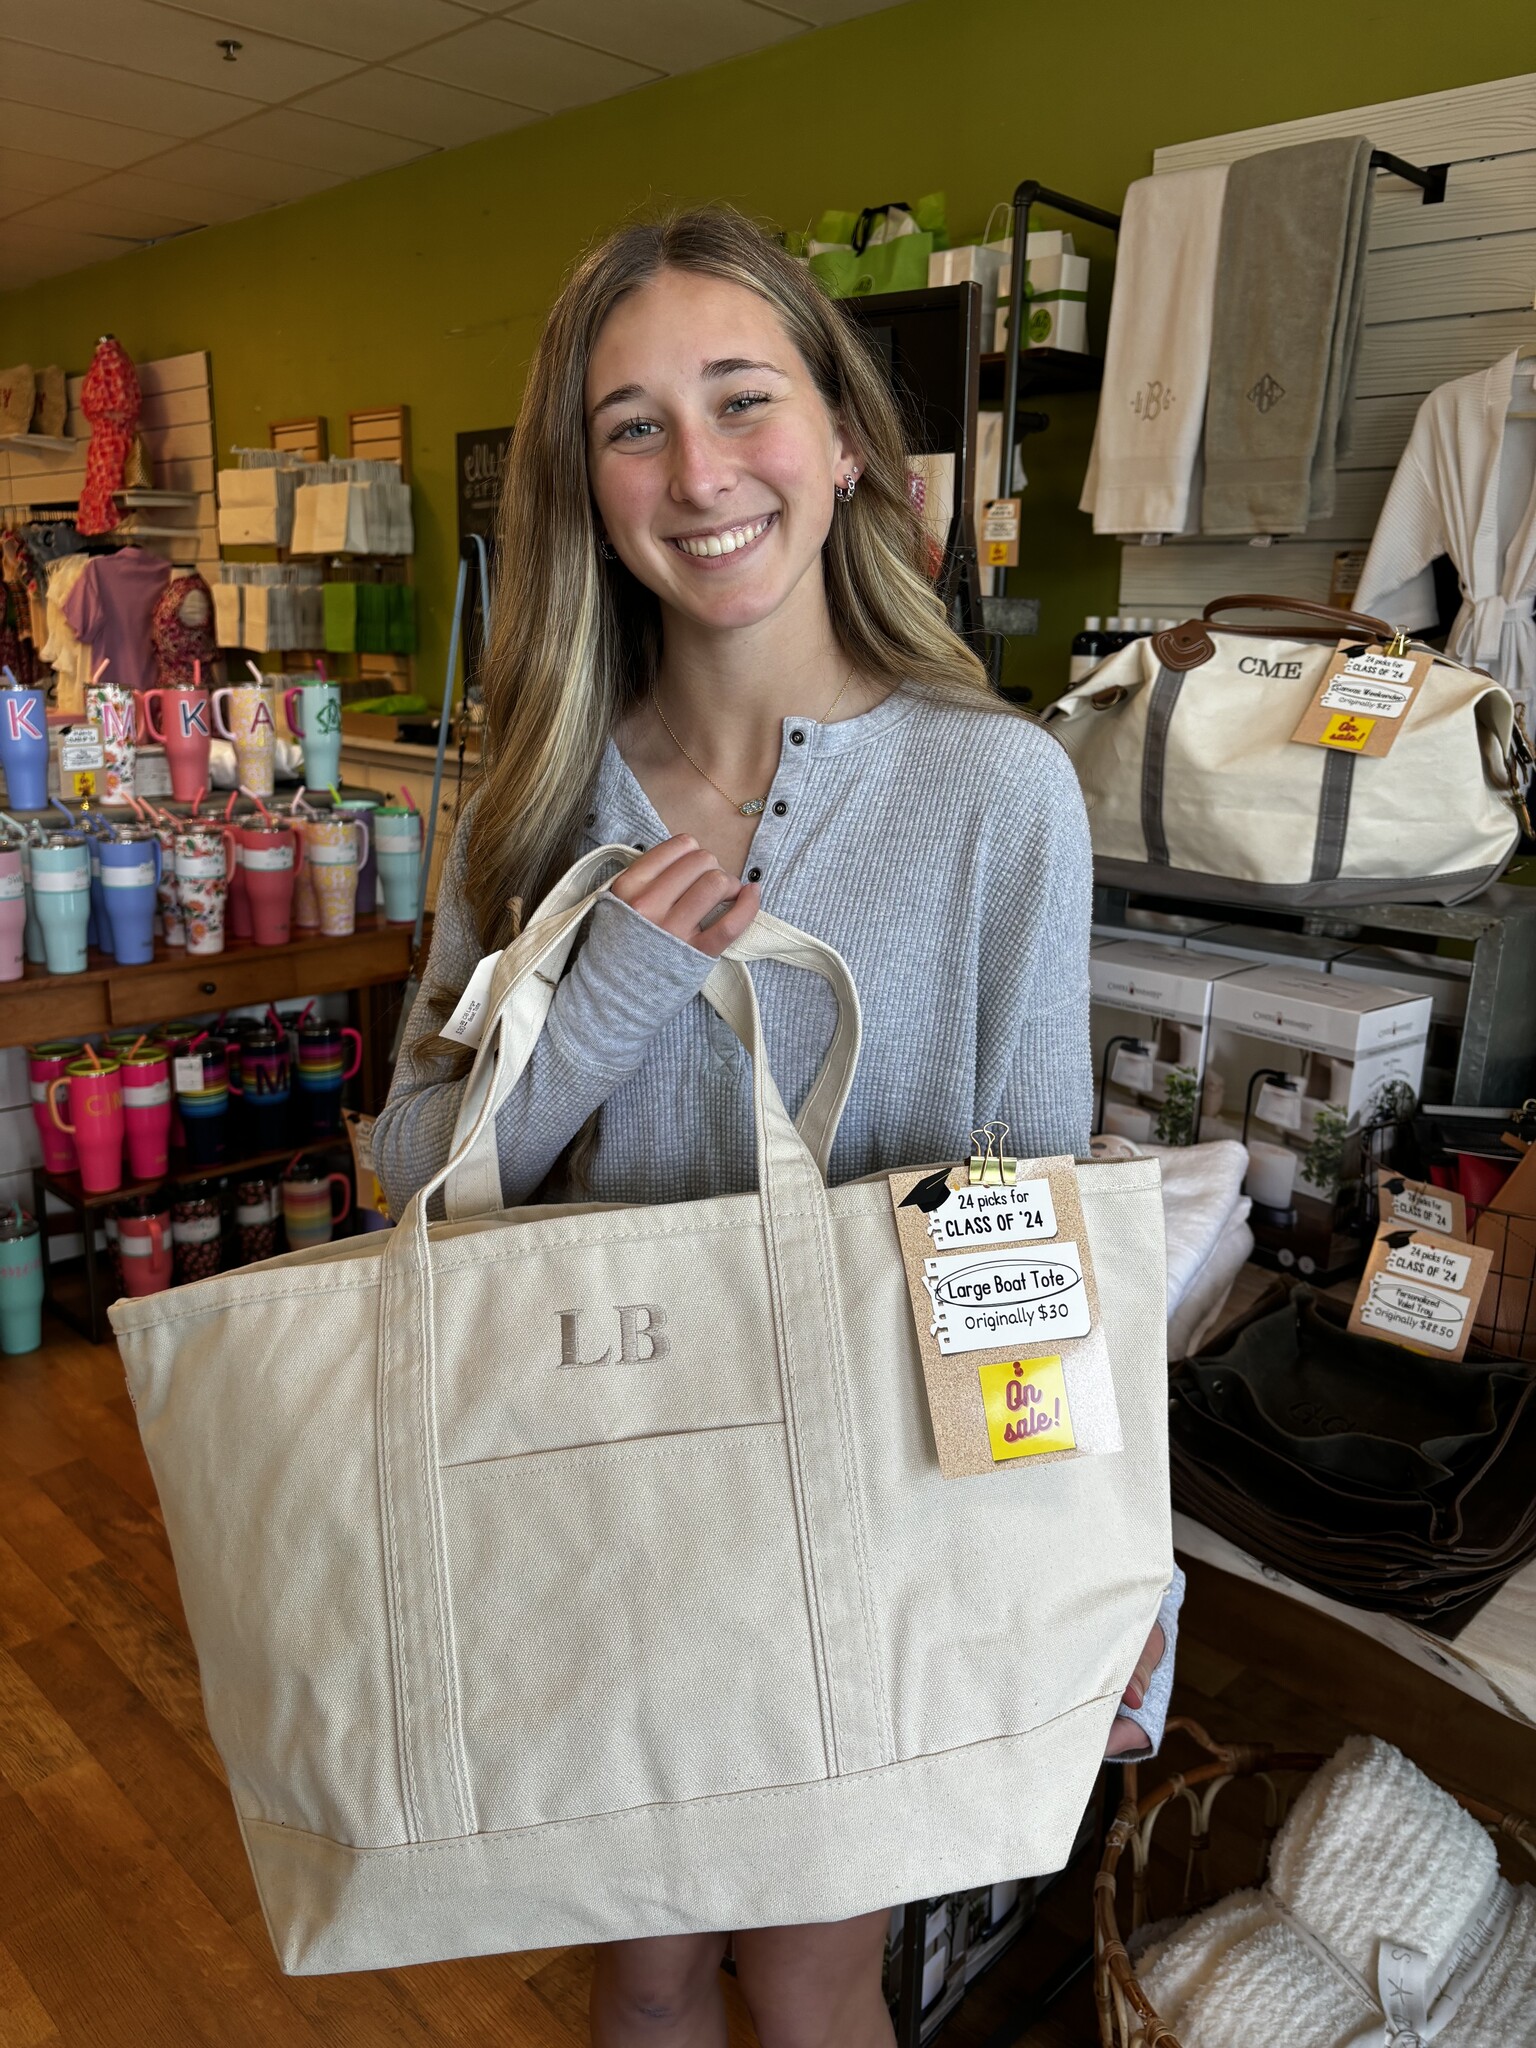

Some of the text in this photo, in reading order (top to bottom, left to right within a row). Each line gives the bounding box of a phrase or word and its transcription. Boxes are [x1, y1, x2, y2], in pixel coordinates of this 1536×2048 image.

[1238, 656, 1303, 680] CME
[1352, 663, 1378, 674] CLASS
[1378, 668, 1390, 676] OF
[7, 698, 43, 740] K
[101, 702, 136, 740] M
[179, 700, 209, 738] K
[251, 701, 275, 733] A
[1338, 721, 1359, 732] On
[255, 1060, 289, 1096] M
[957, 1189, 1029, 1212] 24 picks for
[1400, 1203, 1422, 1218] CLASS
[1423, 1210, 1433, 1221] OF
[945, 1210, 1044, 1238] CLASS OF '24
[1396, 1257, 1458, 1283] CLASS OF '24
[1411, 1246, 1456, 1267] 24 picks for
[947, 1269, 1065, 1301] Large Boat Tote
[1396, 1288, 1441, 1308] Personalized
[965, 1303, 1069, 1332] Originally $30
[1374, 1307, 1420, 1330] Originally
[1417, 1303, 1435, 1319] Tray
[554, 1303, 671, 1370] LB
[1006, 1380, 1042, 1412] On
[1003, 1397, 1061, 1444] sale!
